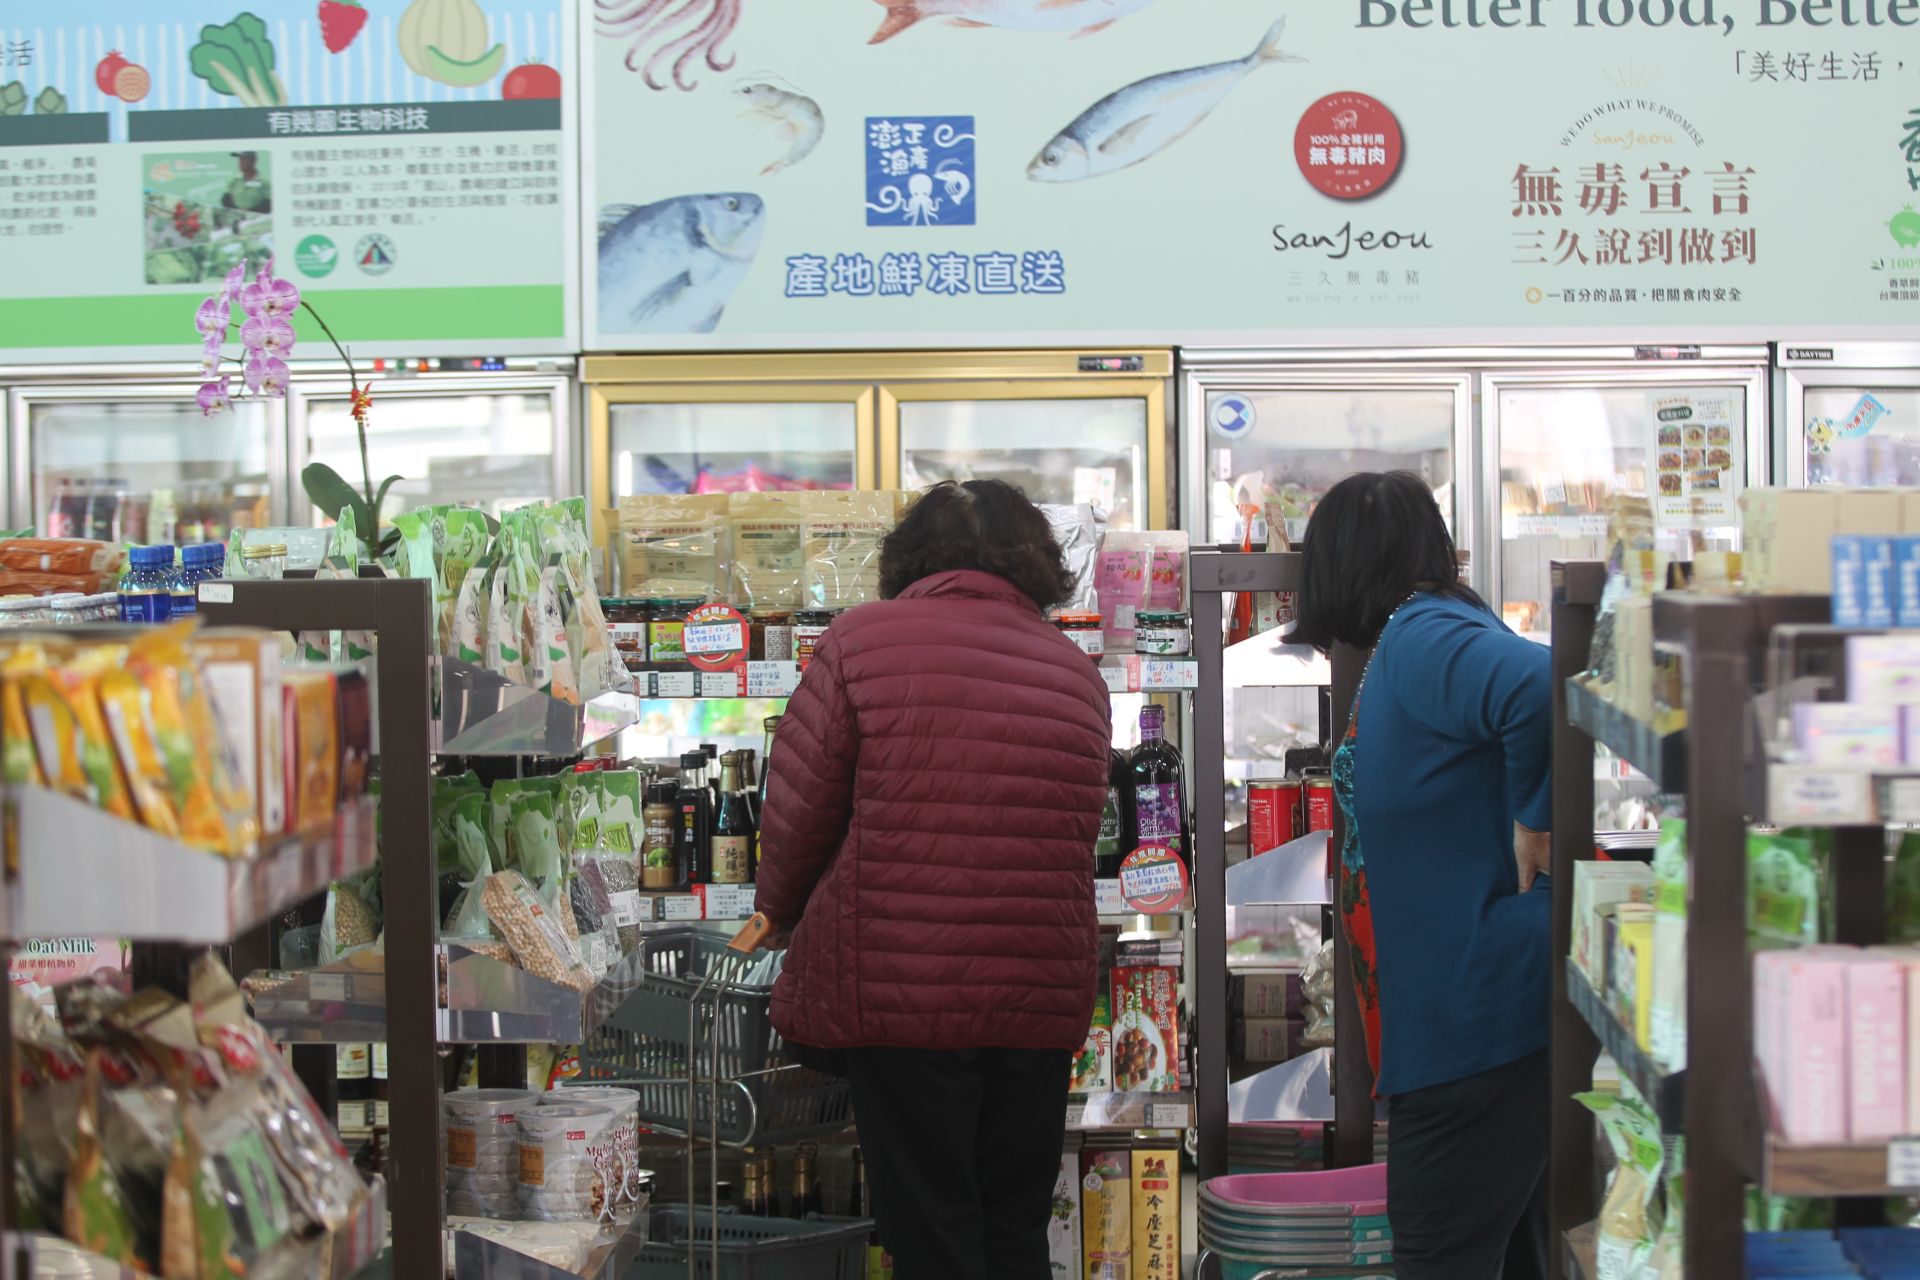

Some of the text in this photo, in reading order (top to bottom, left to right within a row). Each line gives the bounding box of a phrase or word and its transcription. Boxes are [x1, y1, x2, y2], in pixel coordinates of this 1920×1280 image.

[1576, 113, 1593, 130] DO
[1594, 99, 1633, 116] WHAT
[1636, 99, 1656, 112] WE
[1658, 103, 1705, 148] PROMISE
[1309, 146, 1386, 165] 無毒豬肉
[1510, 161, 1757, 217] 無毒宣言
[1510, 227, 1757, 266] 三久說到做到
[784, 250, 1066, 298] 產地鮮凍直送
[1800, 351, 1832, 359] DAYTIME
[28, 938, 97, 954] Oat Milk
